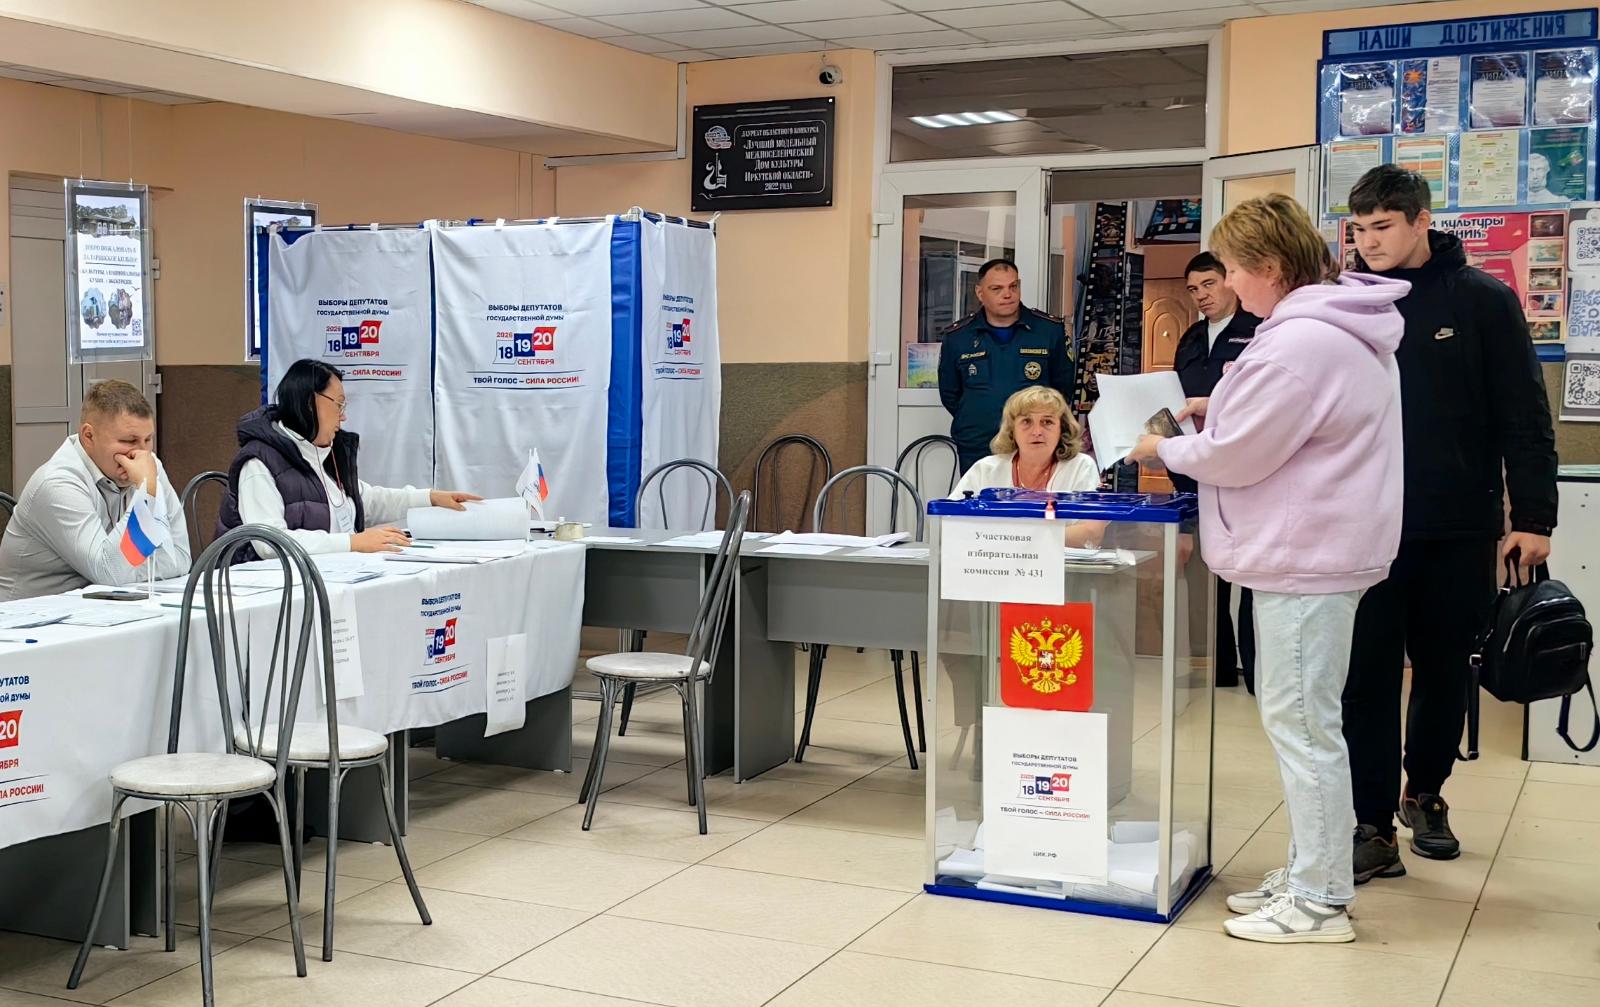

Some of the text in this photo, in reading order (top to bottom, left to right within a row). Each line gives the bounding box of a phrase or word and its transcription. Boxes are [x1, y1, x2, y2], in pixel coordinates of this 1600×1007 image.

[1359, 15, 1566, 50] НАШИ ДОСТИЖЕНИЯ
[316, 308, 371, 316] ГОСУДАРСТВЕННОЙ
[328, 326, 377, 352] 18 19 20
[498, 332, 552, 359] 18 19 20
[473, 376, 492, 384] ТВОЙ
[547, 376, 579, 384] РОССИИ!
[975, 532, 1032, 542] Участковая
[968, 549, 1038, 560] избирательная
[963, 567, 1043, 577] комиссия № 431
[436, 635, 444, 650] 19
[11, 692, 30, 702] ДУМЫ
[0, 719, 17, 739] 20
[10, 784, 44, 797] РОССИИ!
[1022, 778, 1068, 795] 18 19 20
